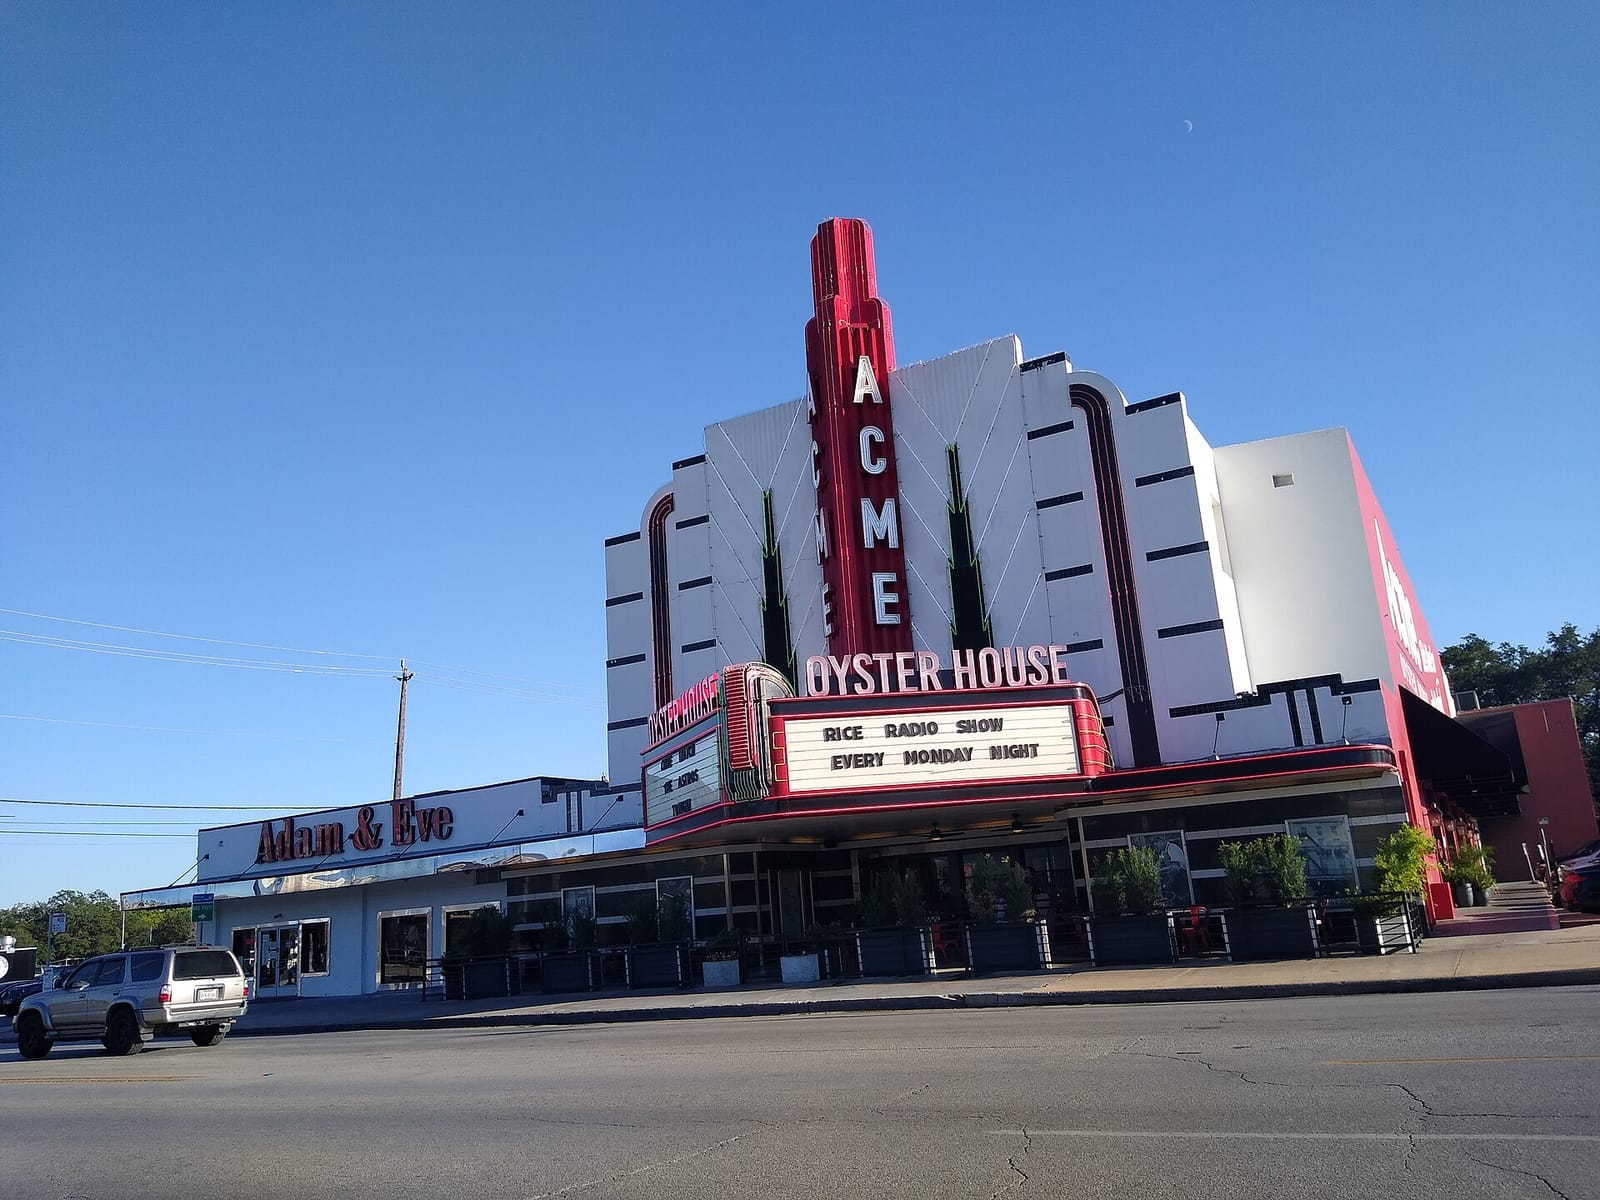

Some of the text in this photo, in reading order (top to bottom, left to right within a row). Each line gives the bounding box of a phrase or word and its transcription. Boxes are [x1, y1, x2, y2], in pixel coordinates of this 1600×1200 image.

[853, 355, 901, 625] ACME
[807, 644, 1072, 697] OYSTER HOUSE
[648, 672, 720, 745] OYSTER HOUSE
[823, 717, 1004, 742] RICE RADIO SHOW
[831, 743, 1039, 771] EVERY MONDAY NIGHT
[257, 799, 454, 864] Adam & Eve
